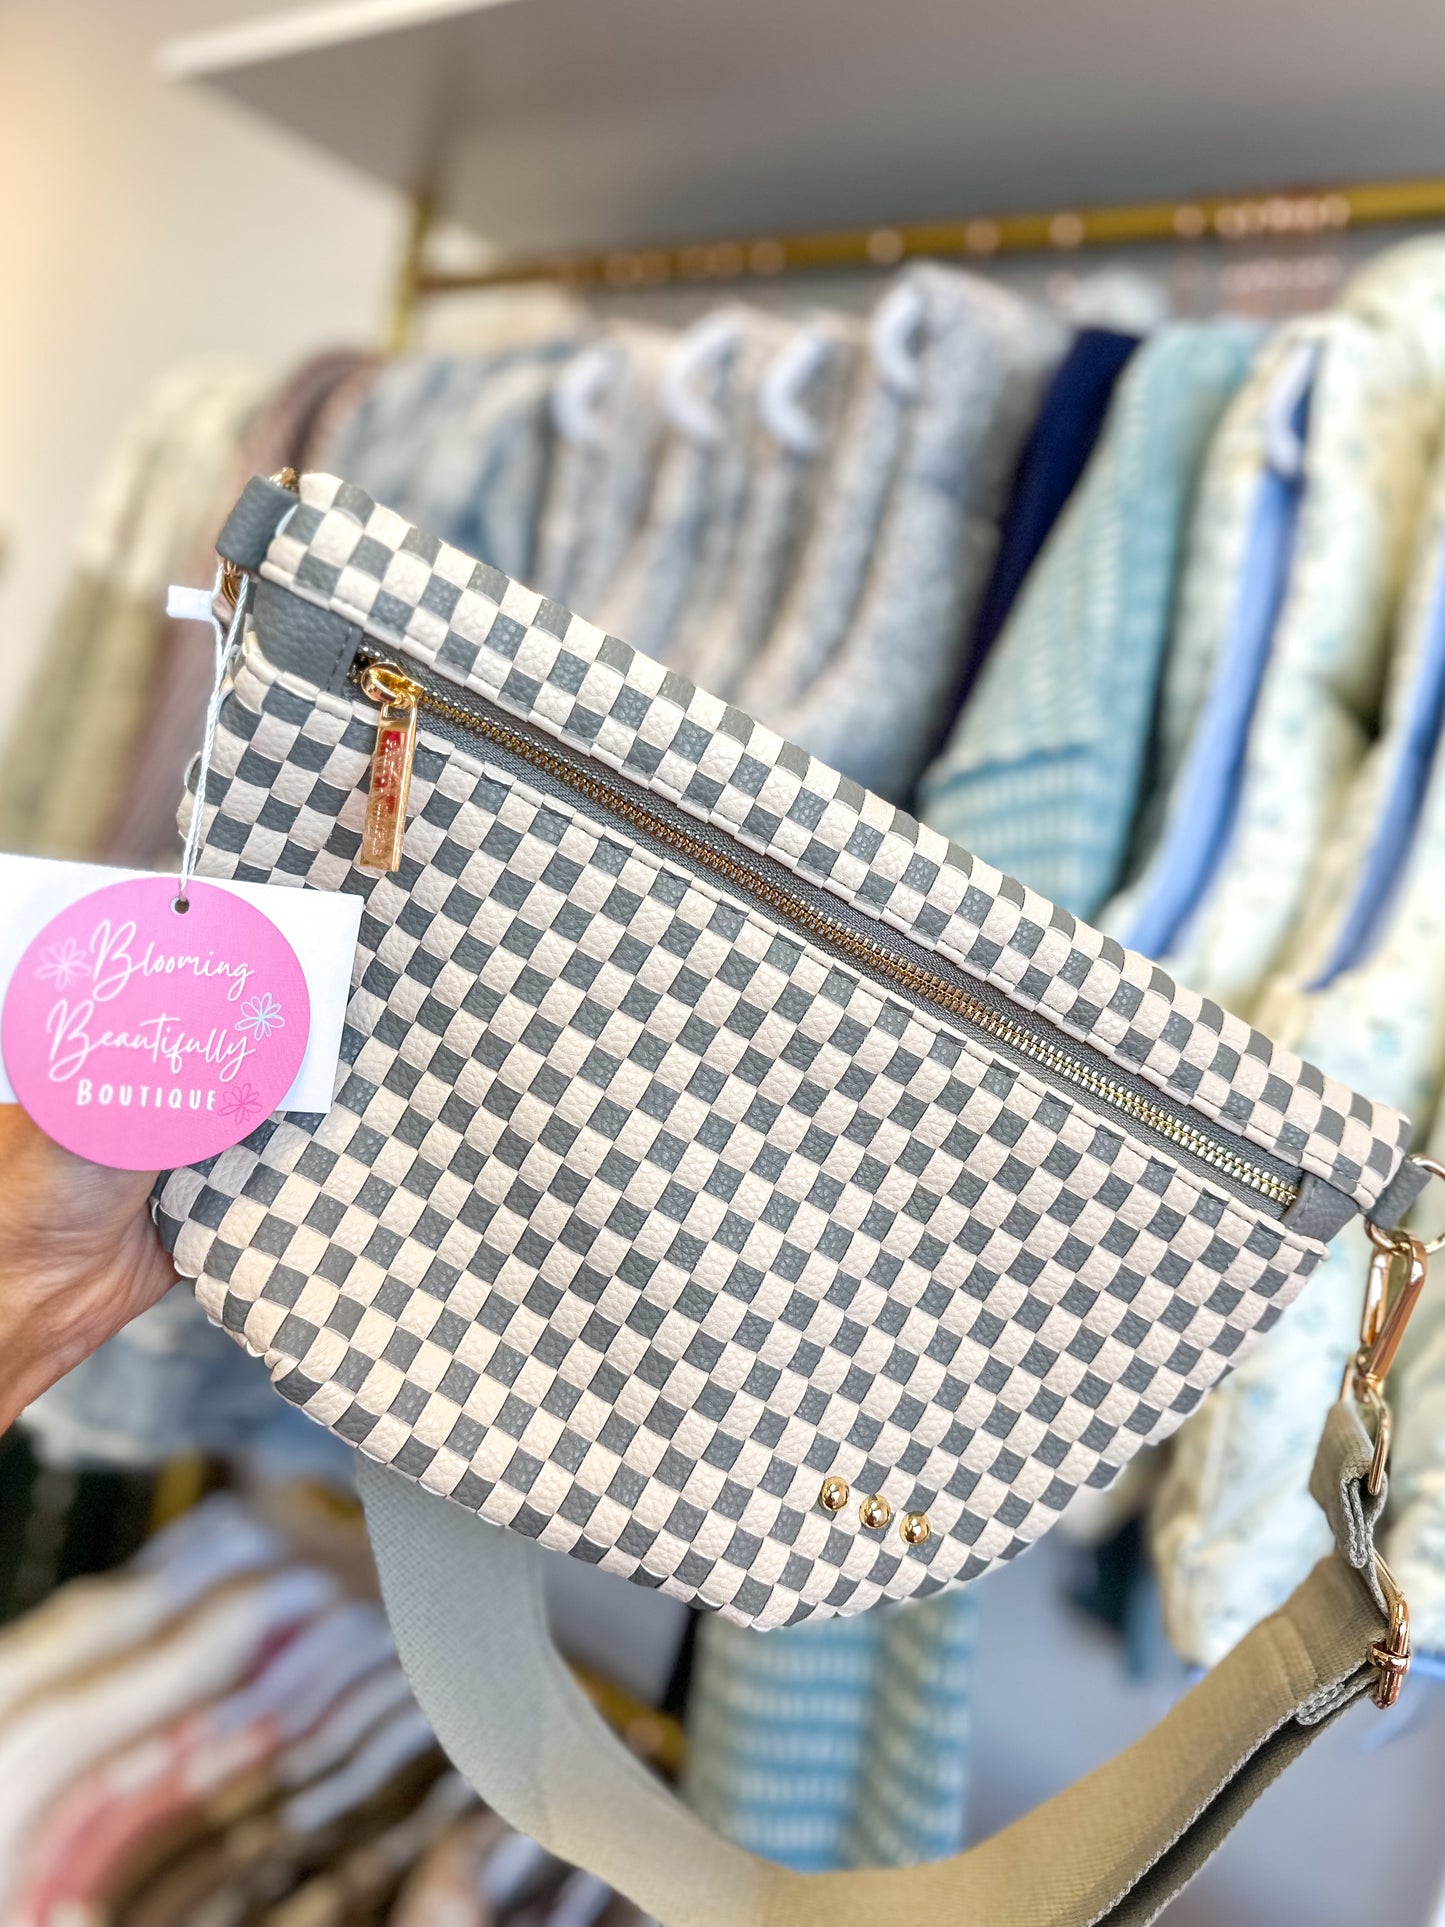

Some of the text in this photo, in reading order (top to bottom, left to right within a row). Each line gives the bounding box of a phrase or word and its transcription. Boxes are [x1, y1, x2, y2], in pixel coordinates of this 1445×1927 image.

[90, 920, 254, 1000] Blooming
[46, 999, 255, 1082] Beautifully
[77, 1080, 216, 1111] BOUTIQUE
